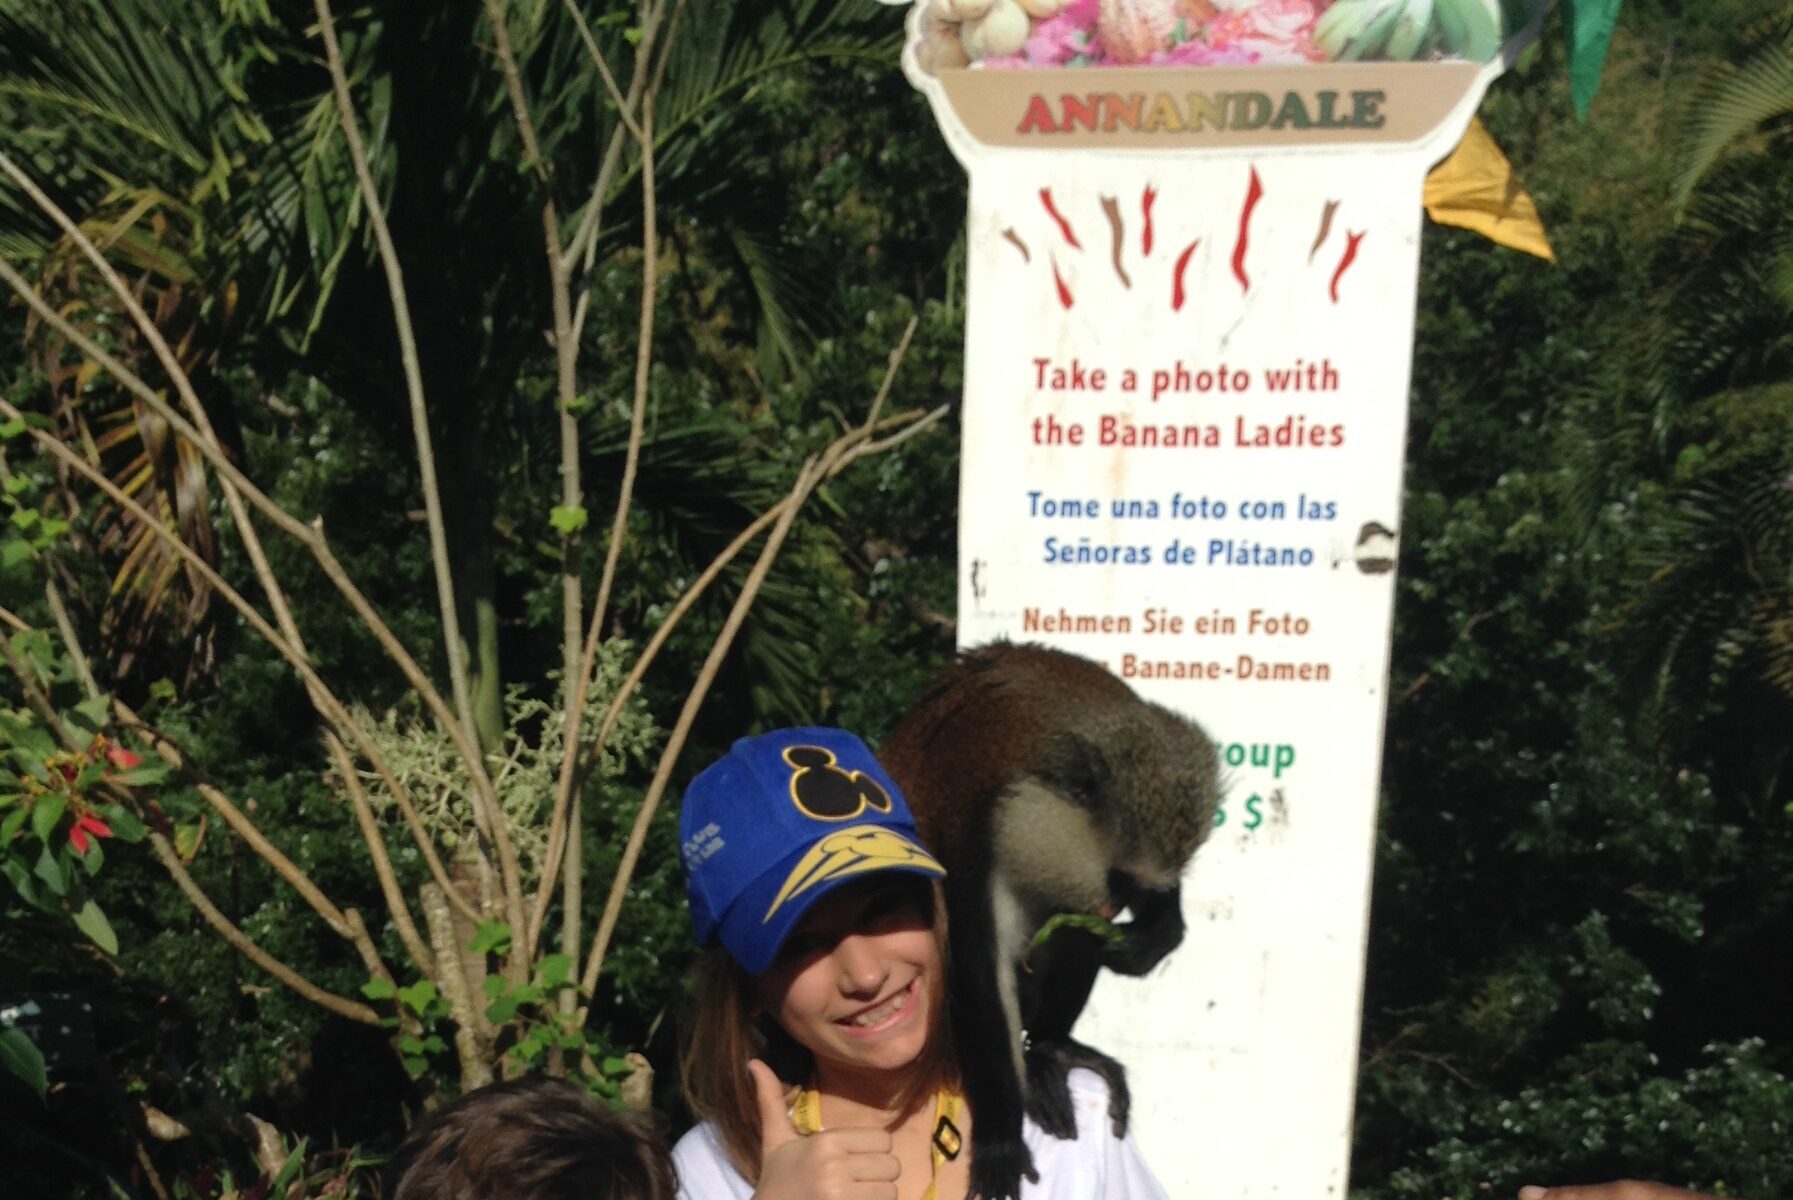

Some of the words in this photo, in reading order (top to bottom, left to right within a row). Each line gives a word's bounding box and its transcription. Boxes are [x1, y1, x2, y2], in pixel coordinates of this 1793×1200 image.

[1016, 90, 1386, 133] ANNANDALE
[1033, 357, 1107, 393] Take
[1120, 369, 1138, 393] a
[1151, 362, 1251, 402] photo
[1265, 359, 1340, 393] with
[1032, 415, 1085, 447] the
[1098, 414, 1221, 448] Banana
[1235, 415, 1345, 448] Ladies
[1027, 491, 1100, 520] Tome
[1111, 500, 1160, 521] una
[1171, 492, 1228, 521] foto
[1238, 501, 1286, 521] con
[1298, 494, 1338, 522] las
[1044, 535, 1152, 567] Señoras
[1163, 539, 1197, 567] de
[1207, 538, 1315, 568] Plátano
[1022, 608, 1131, 636] Nehmen
[1143, 610, 1183, 636] Sie
[1194, 611, 1236, 636] ein
[1248, 608, 1310, 636] Foto
[1121, 653, 1331, 682] Banane-Damen
[1214, 742, 1296, 779] oup
